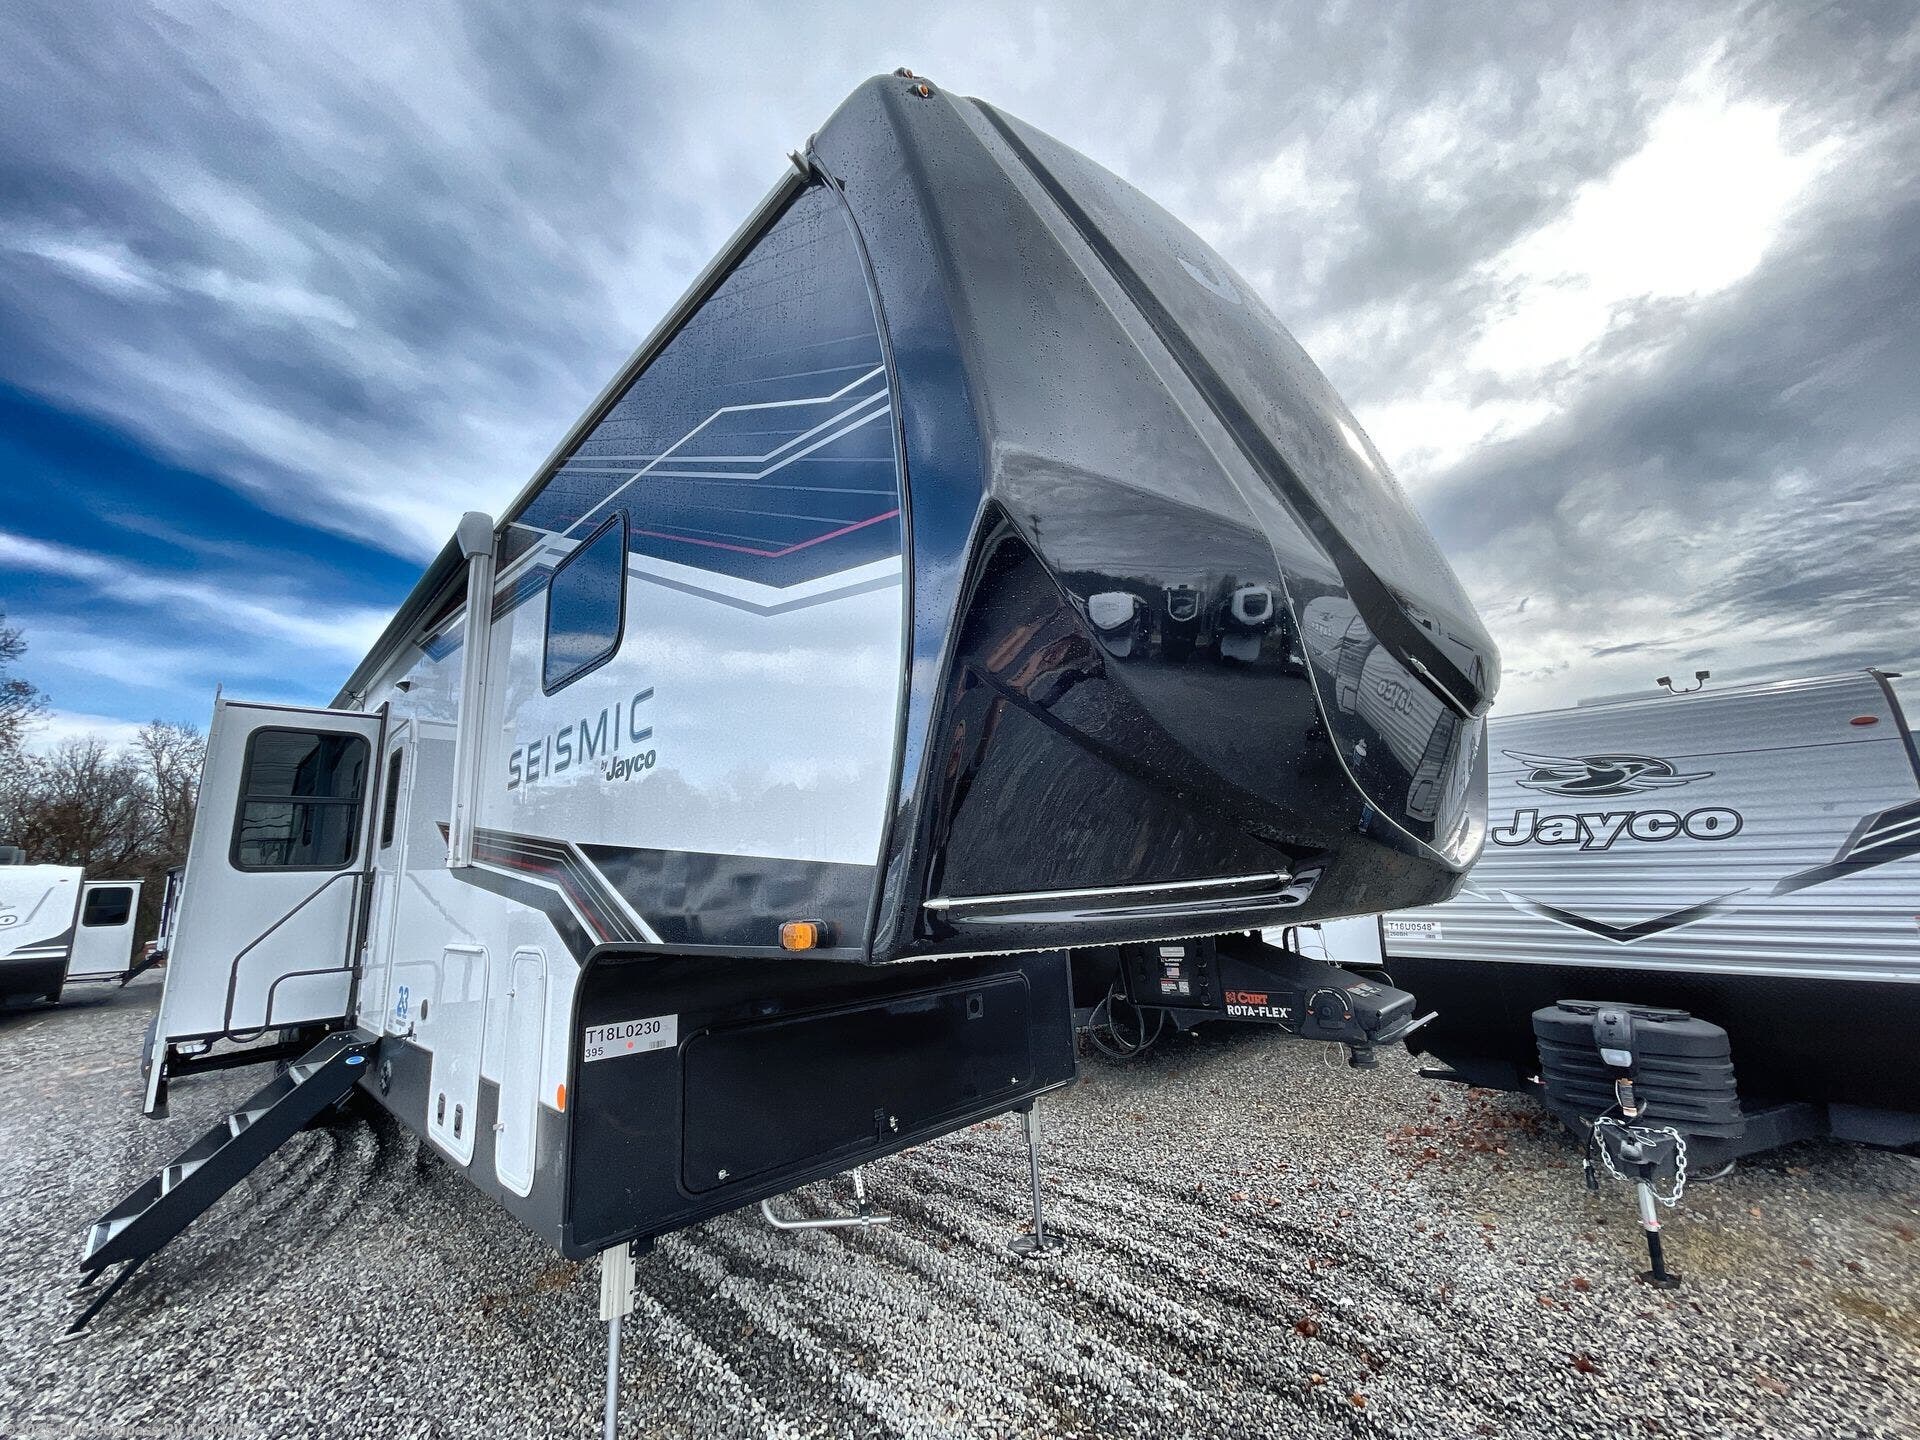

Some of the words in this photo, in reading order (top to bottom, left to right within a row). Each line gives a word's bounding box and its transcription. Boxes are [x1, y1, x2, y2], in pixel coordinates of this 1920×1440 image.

[507, 686, 655, 791] SEISMIC
[606, 748, 657, 782] Jayco
[1491, 806, 1744, 852] Jayco
[396, 985, 409, 1014] 23
[586, 1020, 661, 1044] T18L0230
[585, 1046, 604, 1058] 395
